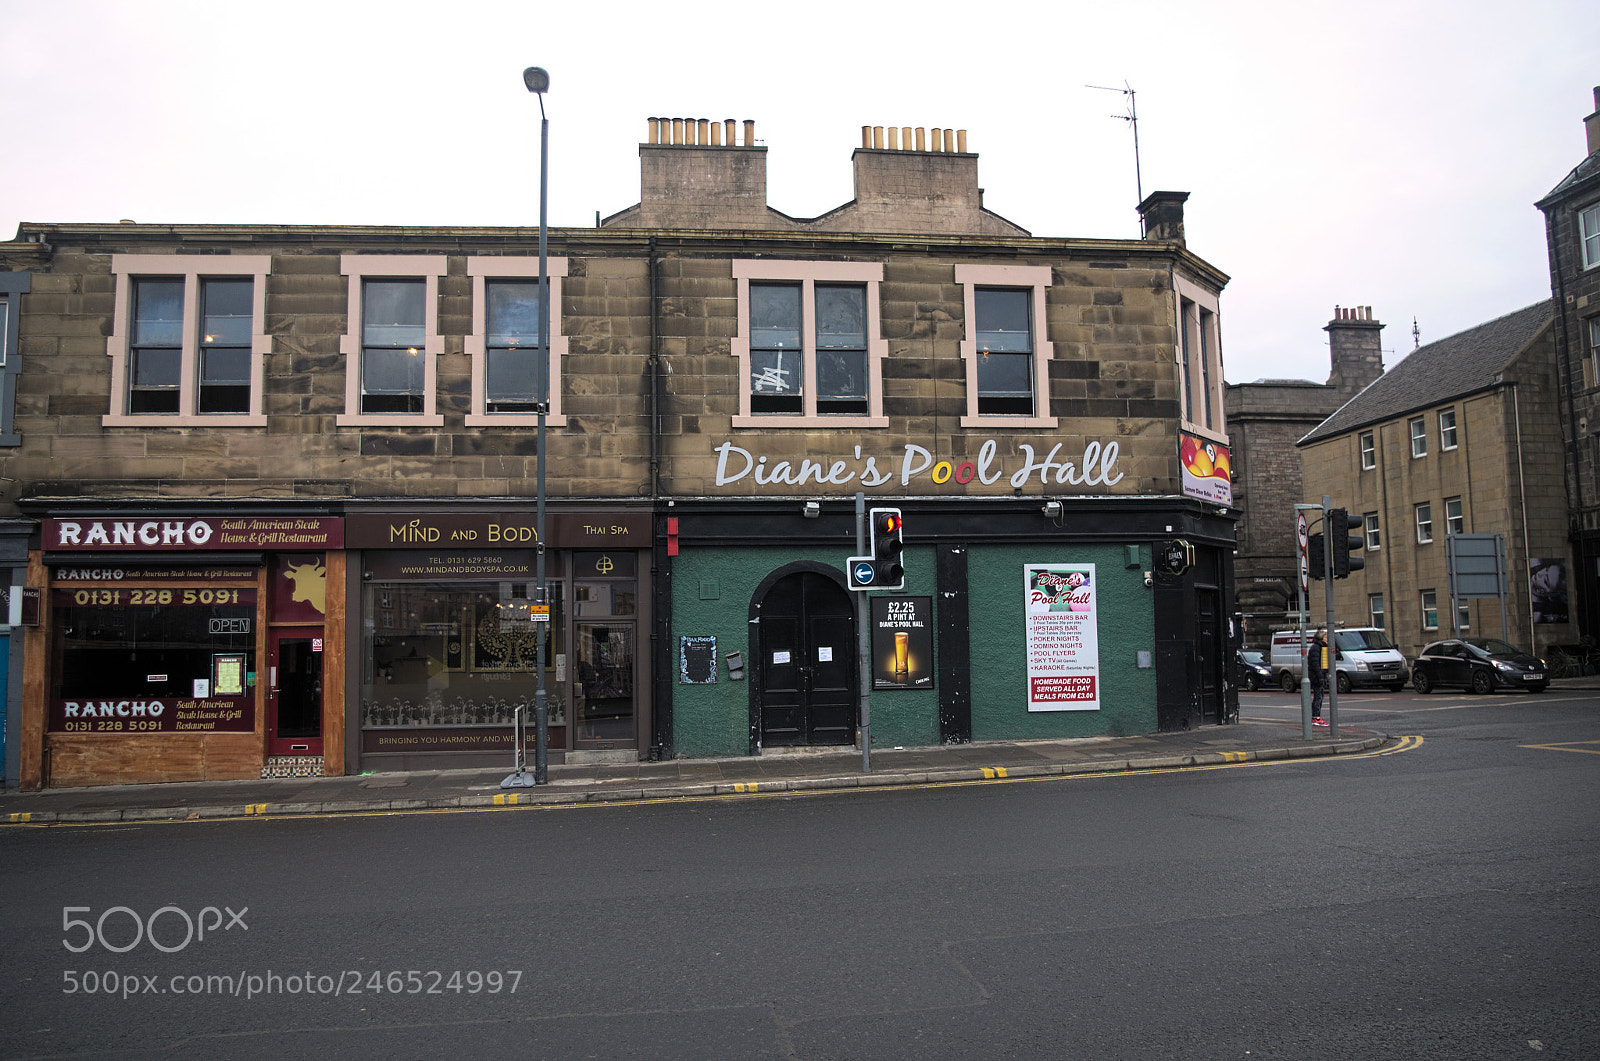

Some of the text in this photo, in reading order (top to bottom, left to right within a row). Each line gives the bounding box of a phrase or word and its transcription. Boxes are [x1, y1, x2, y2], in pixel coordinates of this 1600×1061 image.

[714, 439, 1124, 488] Diane's Pool Hall
[221, 520, 320, 530] South American Steak
[59, 521, 213, 546] RANCHO
[220, 532, 328, 546] House & Grill Restaurant
[451, 530, 478, 541] AND
[57, 569, 124, 580] RANCHO
[210, 570, 222, 578] Grill
[402, 566, 529, 574] WWW.MINDANDBODYSPA.CO.UK
[1038, 573, 1082, 586] Diane's
[74, 589, 239, 605] 0131 228 5091
[1031, 591, 1090, 605] Pool Hall
[888, 602, 914, 613] £2.25
[211, 620, 248, 632] OPEN
[64, 701, 164, 717] RANCHO
[176, 700, 234, 708] South American
[176, 711, 197, 719] Steak
[197, 711, 218, 719] House
[226, 710, 242, 720] Grill
[65, 721, 162, 731] 0131 228 5091
[176, 722, 216, 730] Restaurant
